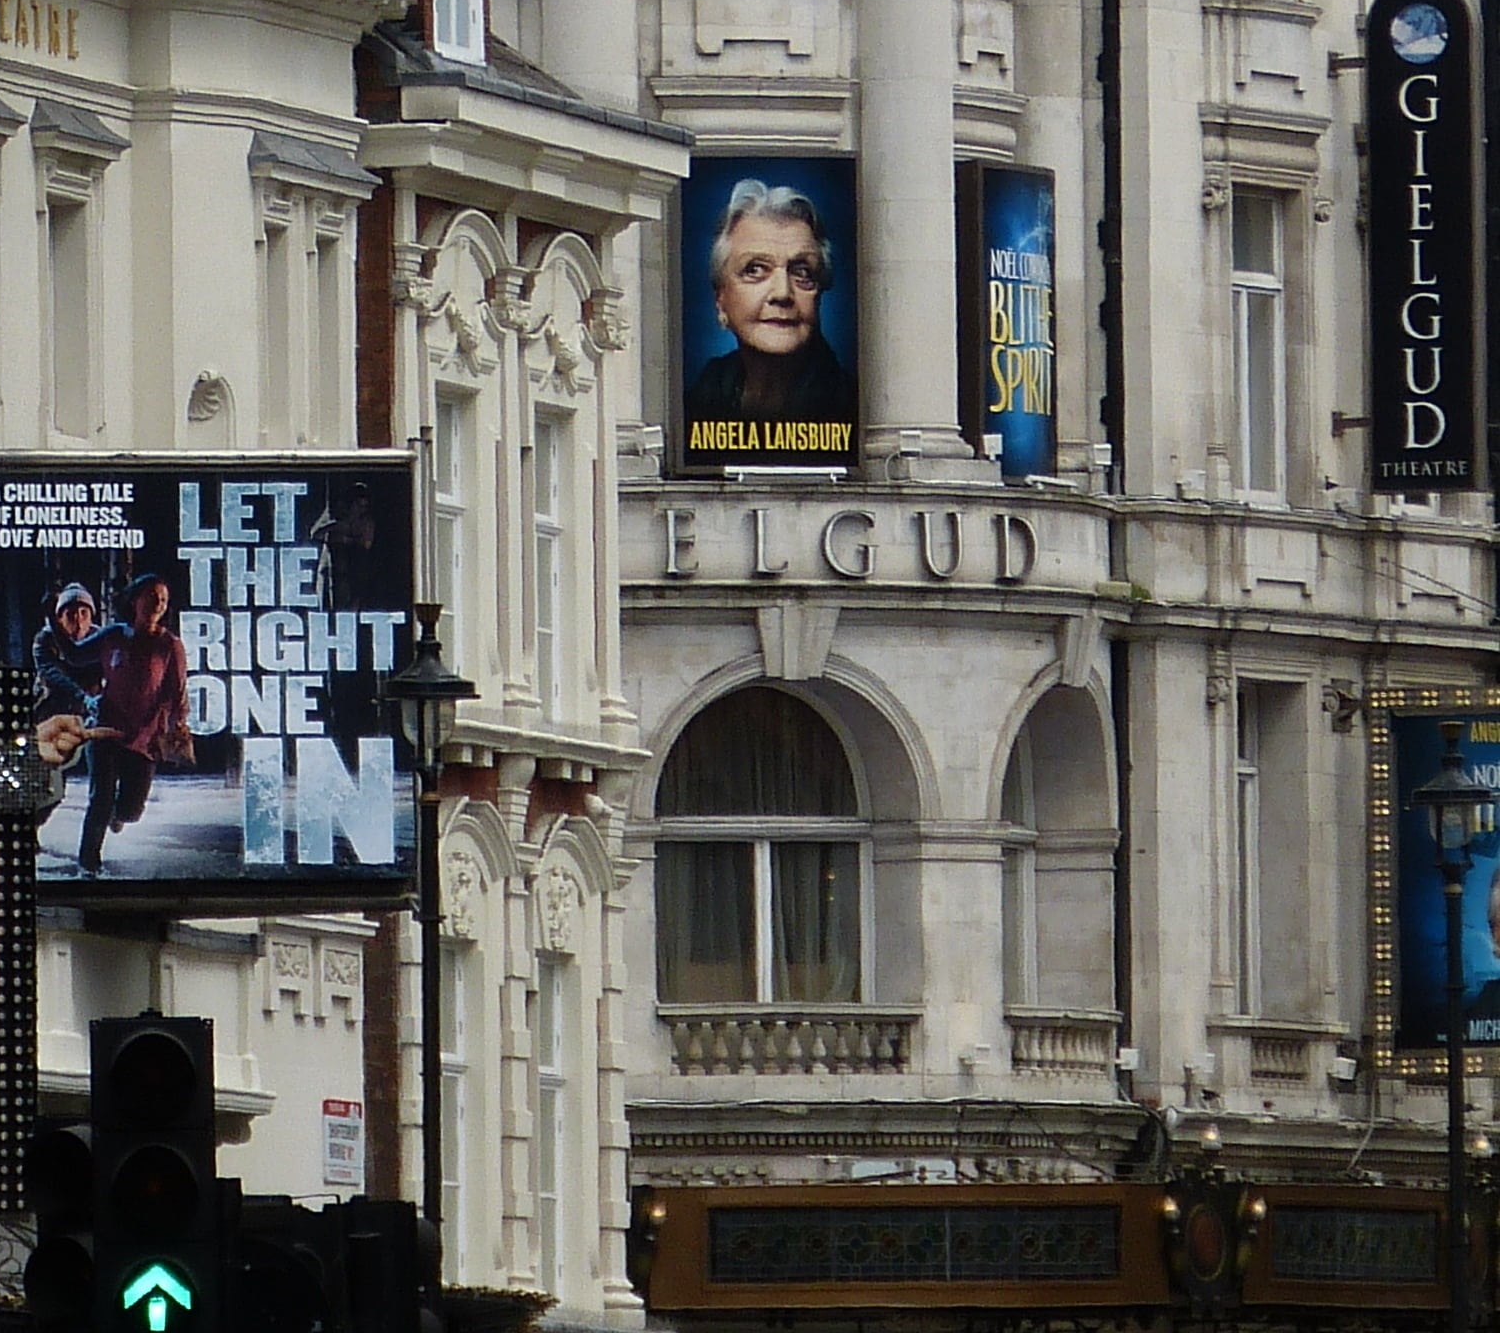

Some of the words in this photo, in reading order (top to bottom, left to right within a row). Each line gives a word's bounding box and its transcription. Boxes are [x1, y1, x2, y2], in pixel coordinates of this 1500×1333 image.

[1399, 74, 1446, 449] GIELGUD
[989, 280, 1053, 347] BLITHE
[989, 344, 1054, 416] SPIRIT
[690, 421, 760, 450] ANGELA
[764, 422, 852, 452] LANSBURY
[3, 483, 88, 503] CHILLING
[90, 483, 134, 502] TALE
[1381, 461, 1469, 477] THEATRE
[14, 506, 128, 527] LONELINESS,
[36, 528, 73, 548] AND
[75, 529, 145, 549] LEGEND
[178, 482, 309, 543] LET
[177, 547, 319, 607] THE
[178, 611, 406, 672] RIGHT
[186, 675, 325, 736] ONE
[243, 737, 396, 865] IN
